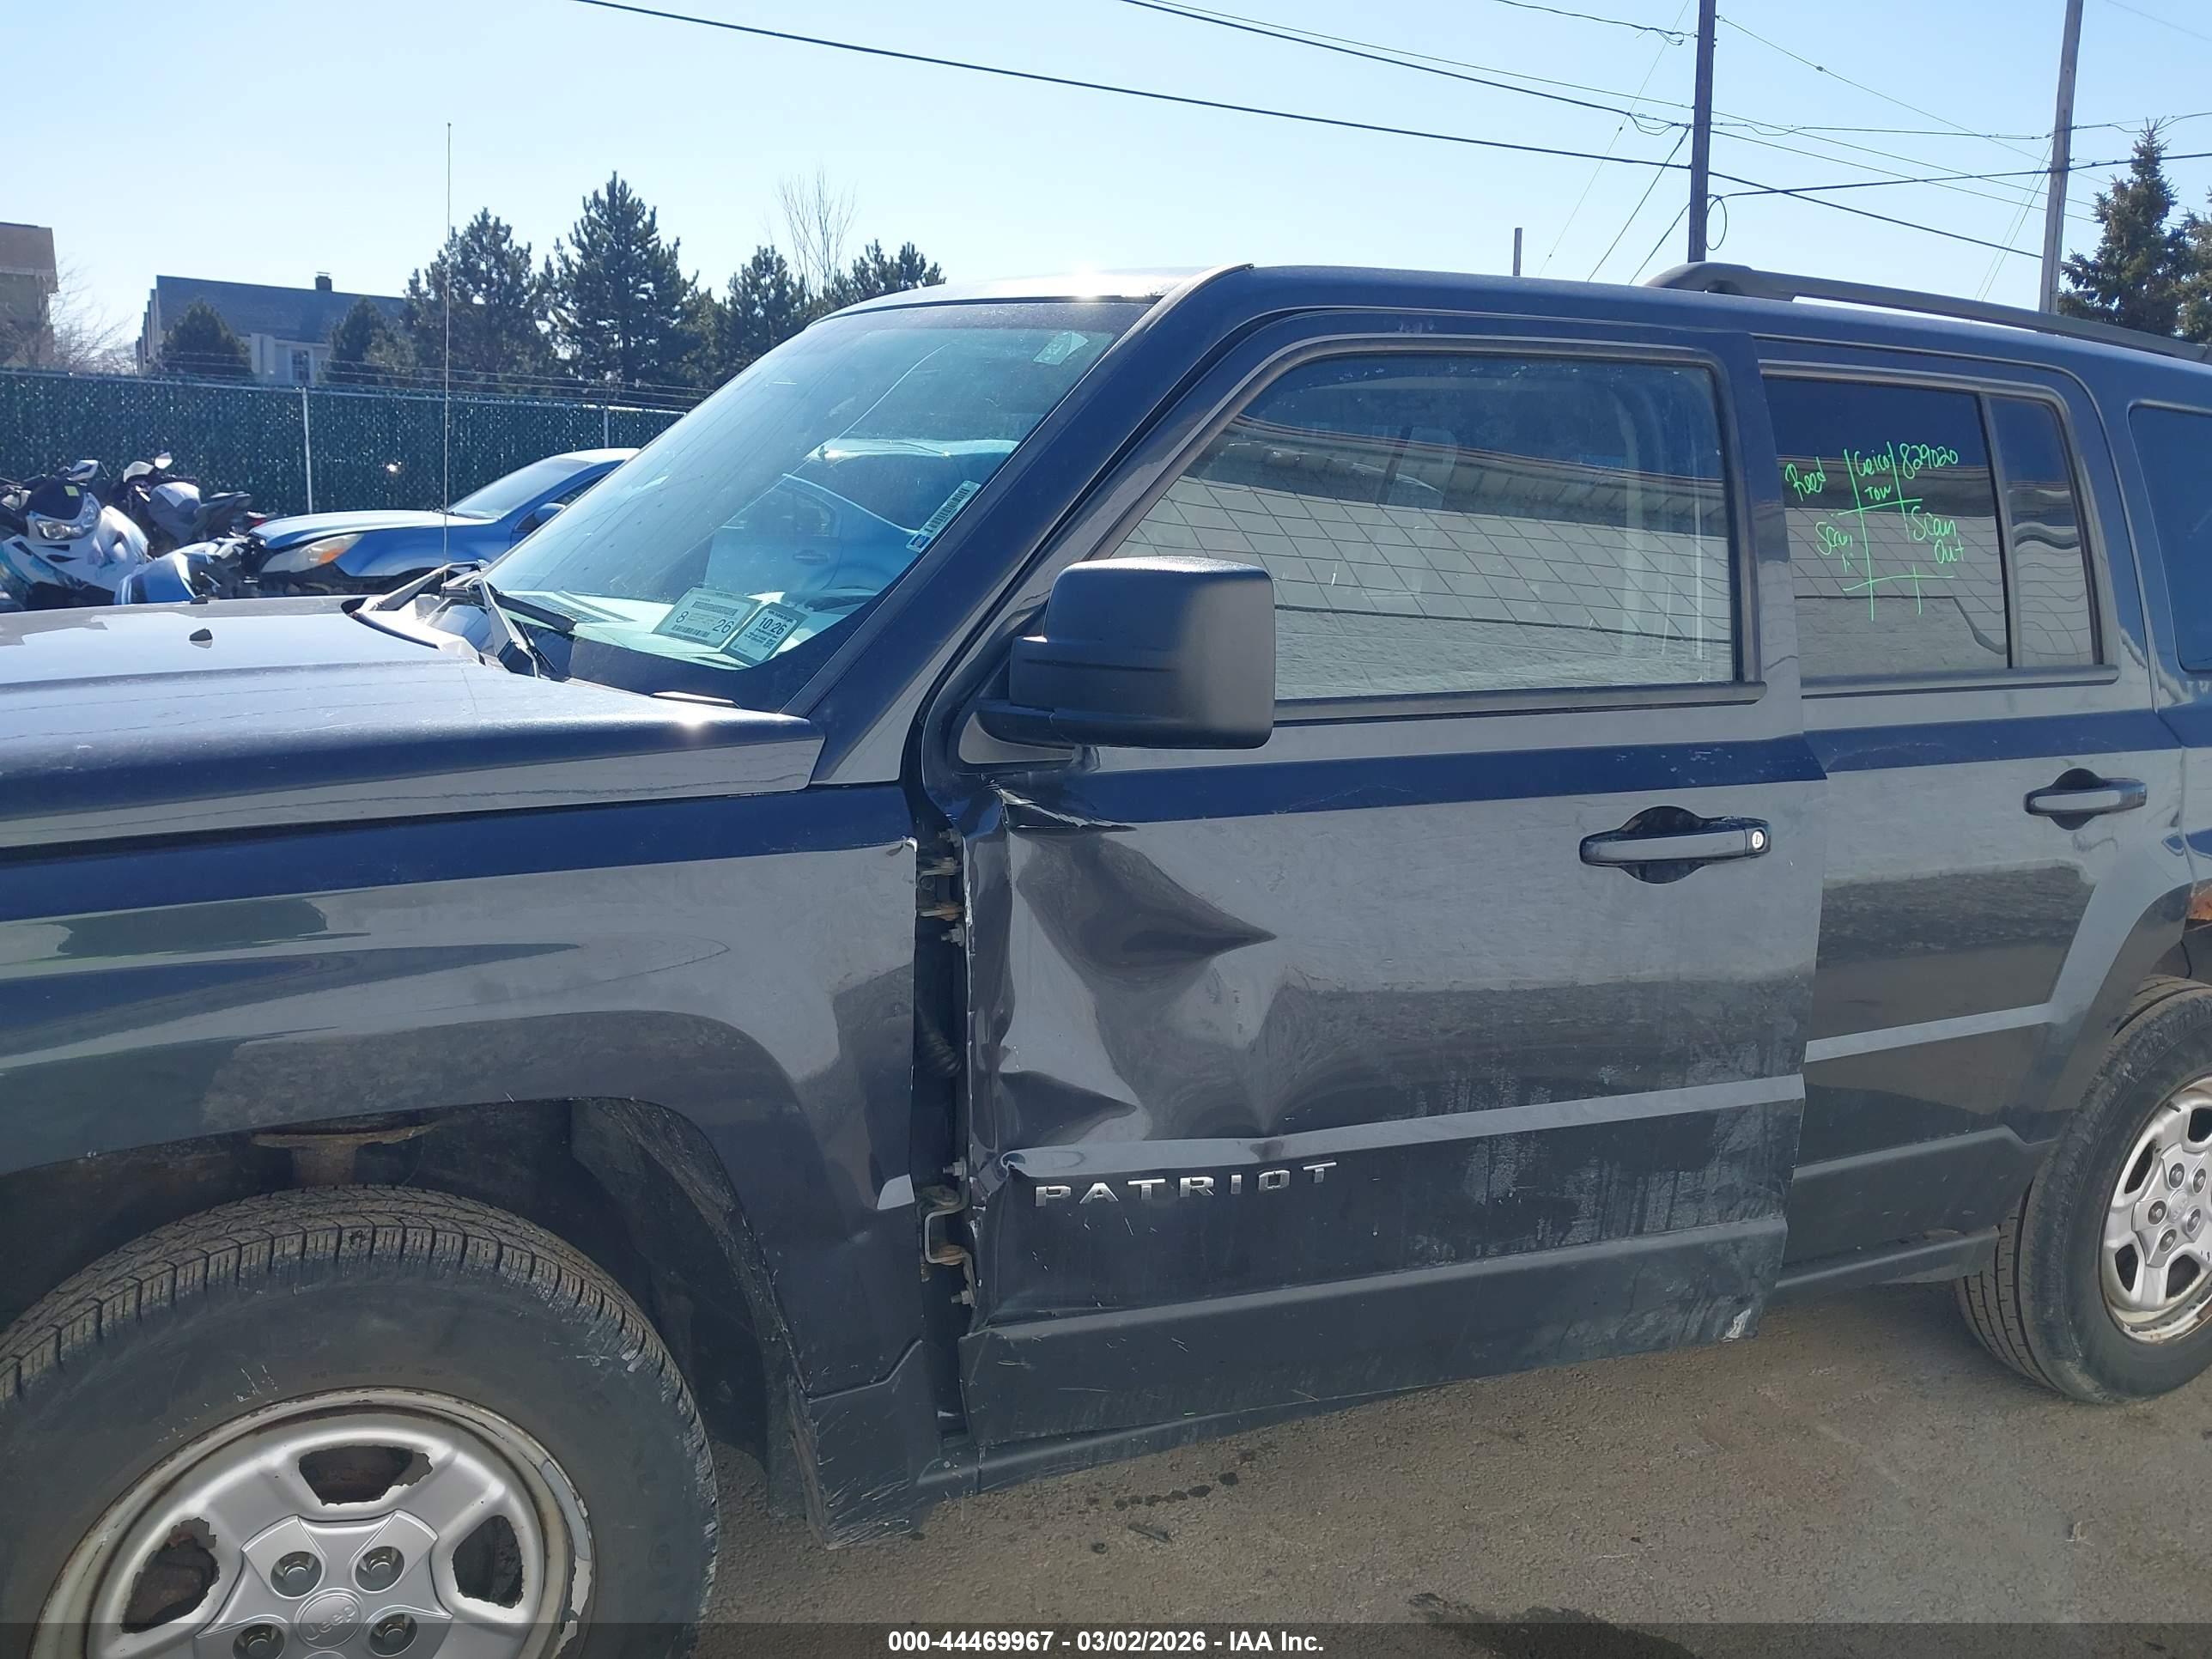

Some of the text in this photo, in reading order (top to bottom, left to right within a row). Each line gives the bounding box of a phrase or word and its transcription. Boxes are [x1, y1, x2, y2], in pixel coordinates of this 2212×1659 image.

[1899, 443, 1958, 479] 829020
[676, 611, 689, 623] 8
[712, 618, 734, 634] 26
[1035, 1161, 1338, 1207] PATRIOT
[305, 1604, 356, 1641] Jeep
